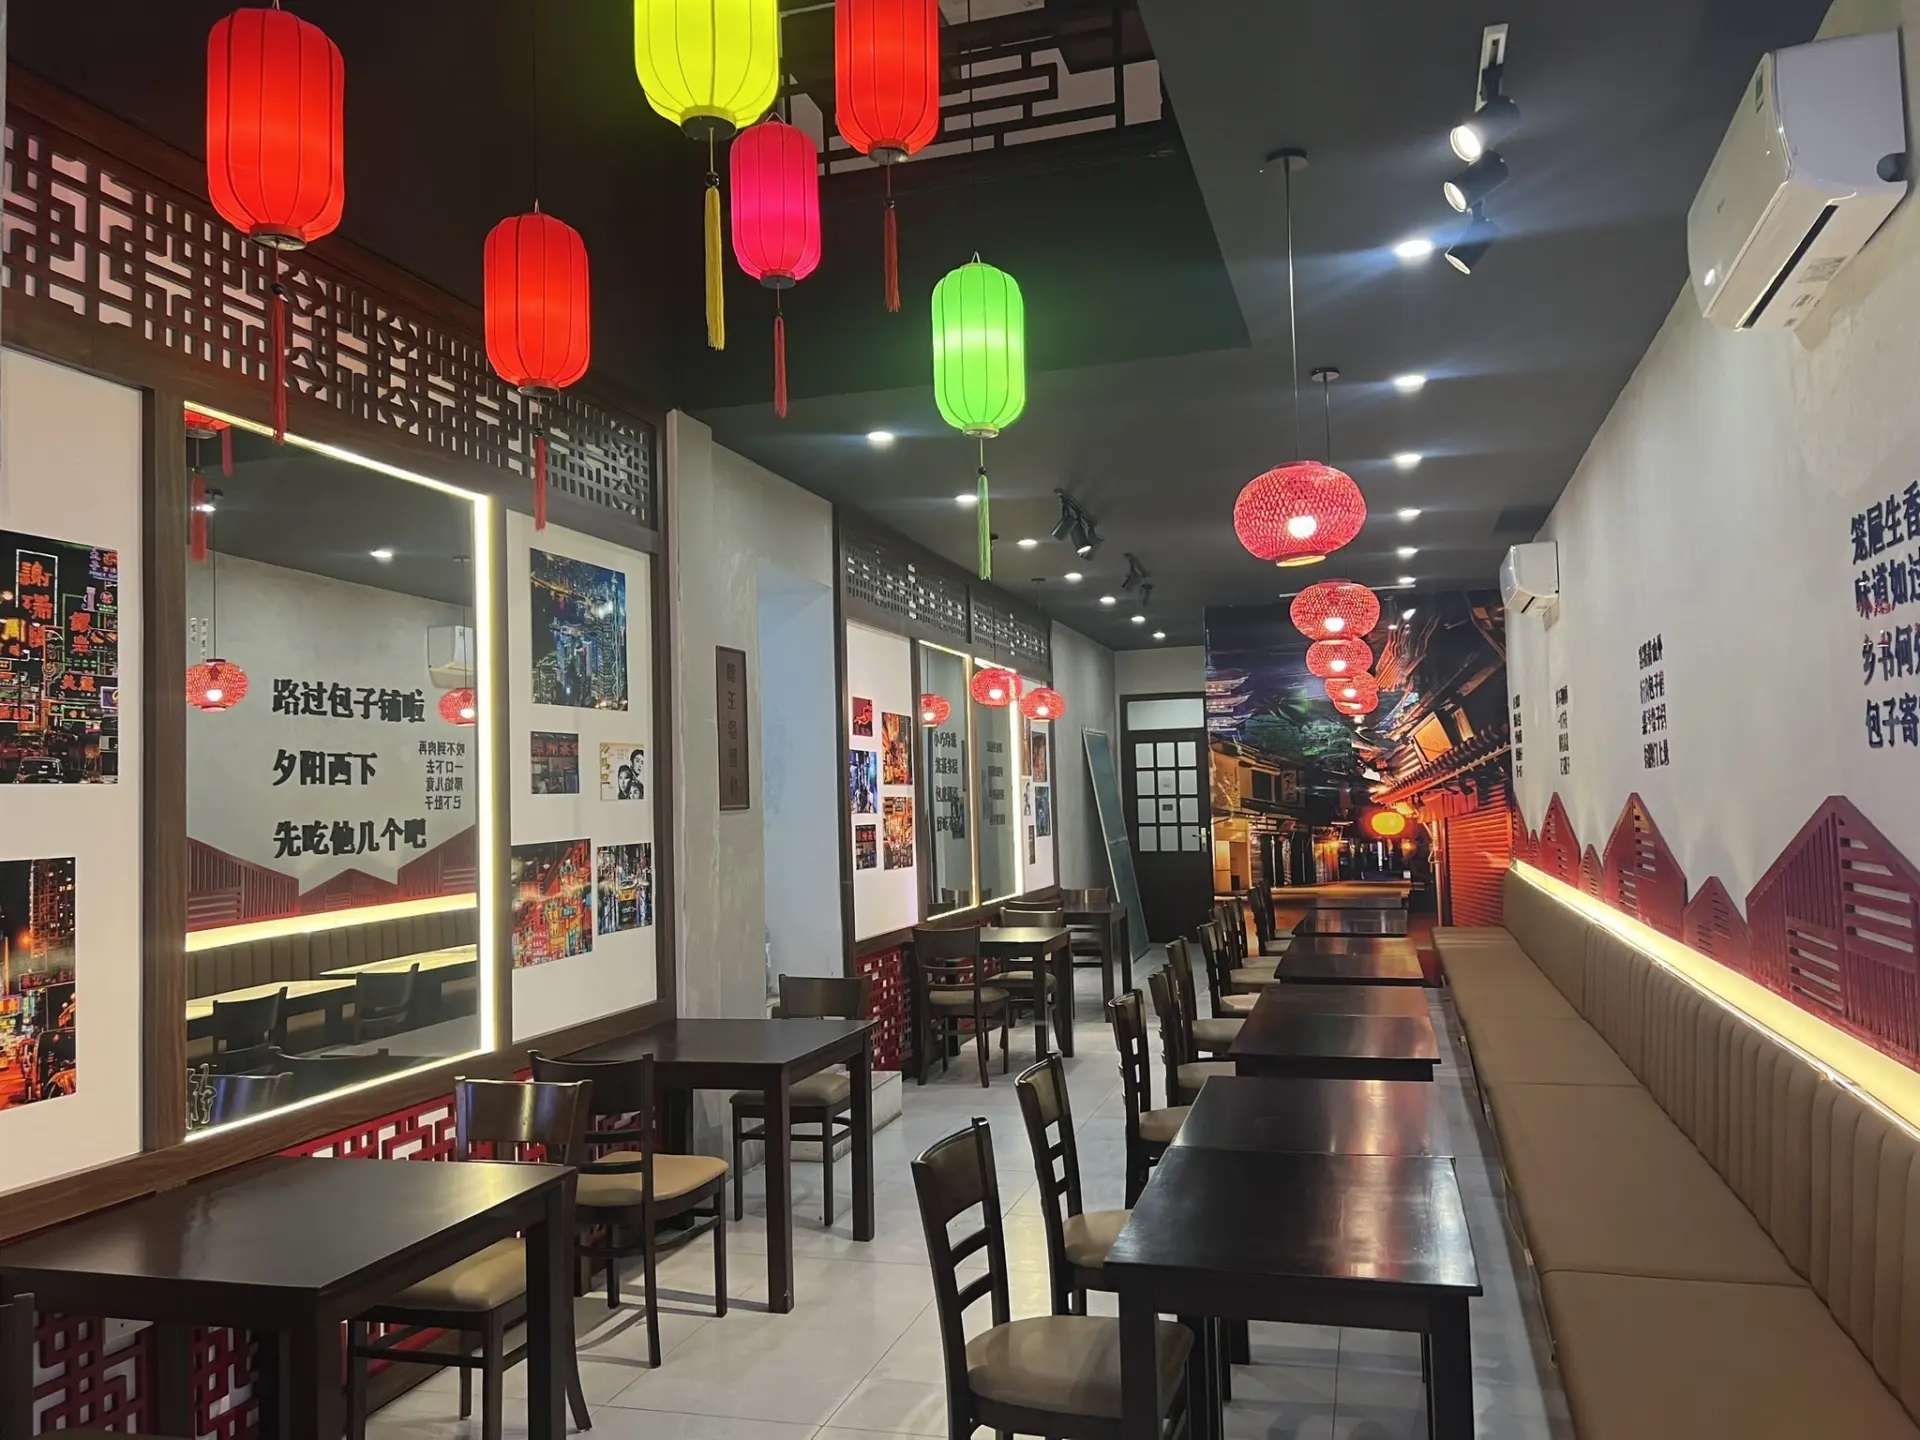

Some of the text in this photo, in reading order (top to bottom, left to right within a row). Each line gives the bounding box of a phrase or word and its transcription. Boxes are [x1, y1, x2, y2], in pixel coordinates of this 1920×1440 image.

[272, 678, 426, 723] 路过包子铺啦
[1865, 692, 1920, 749] 包子寄
[272, 749, 379, 786] 夕阳西下
